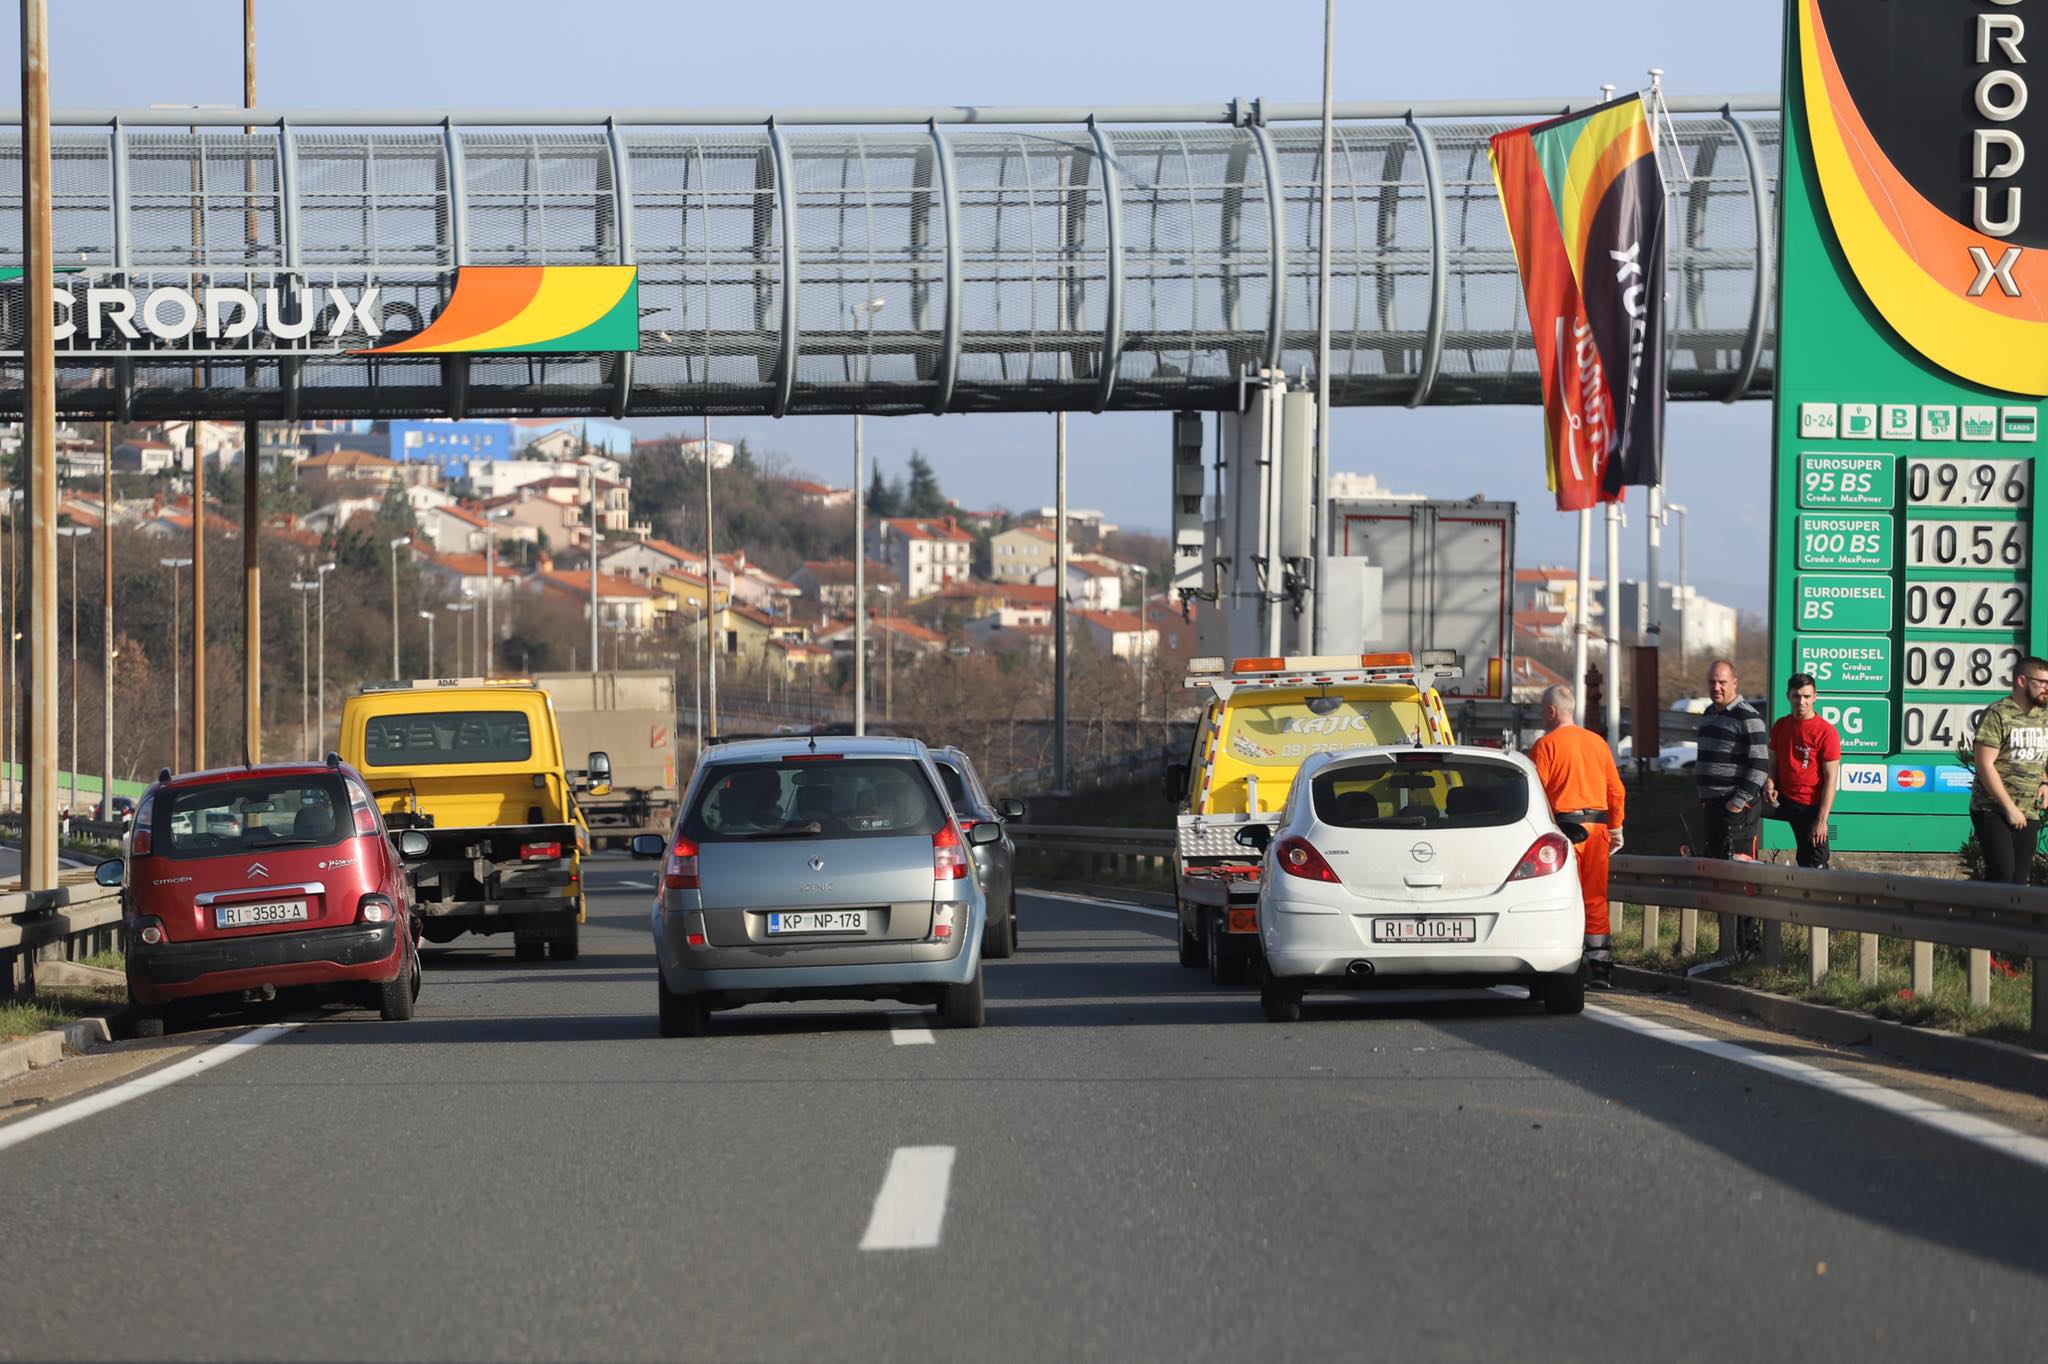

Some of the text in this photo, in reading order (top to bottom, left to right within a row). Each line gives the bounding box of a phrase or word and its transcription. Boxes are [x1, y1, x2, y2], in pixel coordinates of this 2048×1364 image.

[1966, 0, 2028, 297] RODUX
[1804, 414, 1834, 428] 0-24
[1892, 408, 1907, 428] B
[1806, 459, 1882, 470] EUROSUPER
[1805, 472, 1872, 492] 95 BS
[1909, 463, 2025, 504] 09,96
[1806, 493, 1882, 503] Crodux MaxPower
[1804, 520, 1881, 531] EUROSUPER
[1805, 534, 1881, 554] 100 BS
[1911, 524, 2022, 565] 10,56
[1804, 554, 1881, 564] Crodux MaxPower
[1804, 587, 1886, 599] EURODIESEL
[1803, 600, 1834, 620] BS
[1907, 585, 2024, 627] 09,62
[1802, 647, 1885, 660] EURODIESEL
[1803, 661, 1833, 680] BS
[1842, 662, 1872, 671] Crodux
[1906, 646, 2022, 688] 09,83
[437, 679, 459, 687] ADAC
[1842, 673, 1884, 681] MaxPower
[1822, 706, 1863, 734] PG
[1848, 771, 1882, 784] VISA
[226, 903, 301, 923] RI 3583-A
[783, 913, 861, 929] KP NP-178
[1385, 922, 1462, 937] RI 010-H
